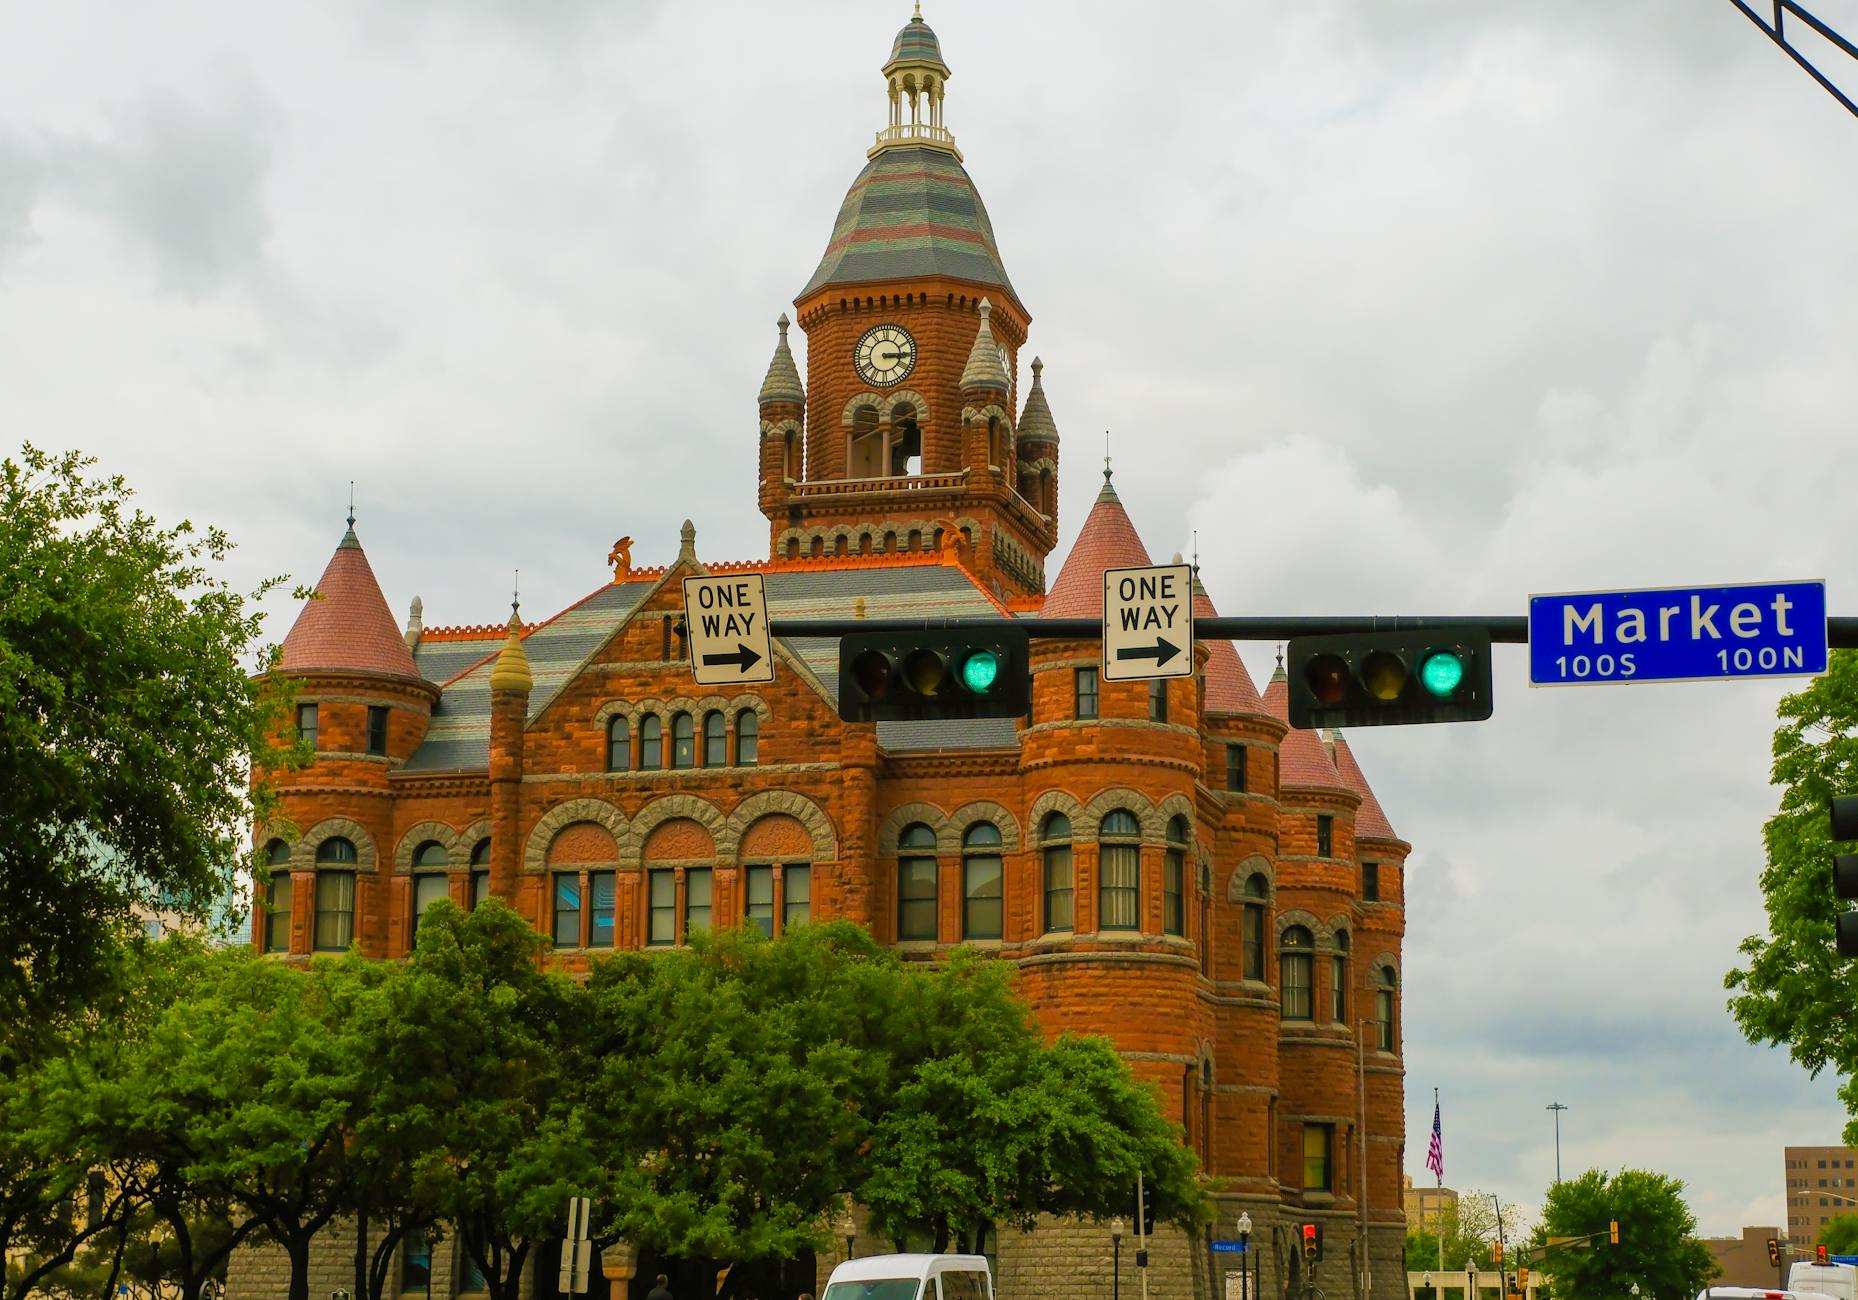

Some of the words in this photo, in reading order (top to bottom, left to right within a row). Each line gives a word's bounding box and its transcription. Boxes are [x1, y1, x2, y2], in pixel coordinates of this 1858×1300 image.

[698, 583, 752, 609] ONE
[1119, 575, 1176, 602] ONE
[701, 612, 756, 638] WAY
[1120, 604, 1179, 632] WAY
[1563, 592, 1794, 646] Market
[1555, 653, 1637, 678] 100S
[1716, 646, 1804, 672] 100N
